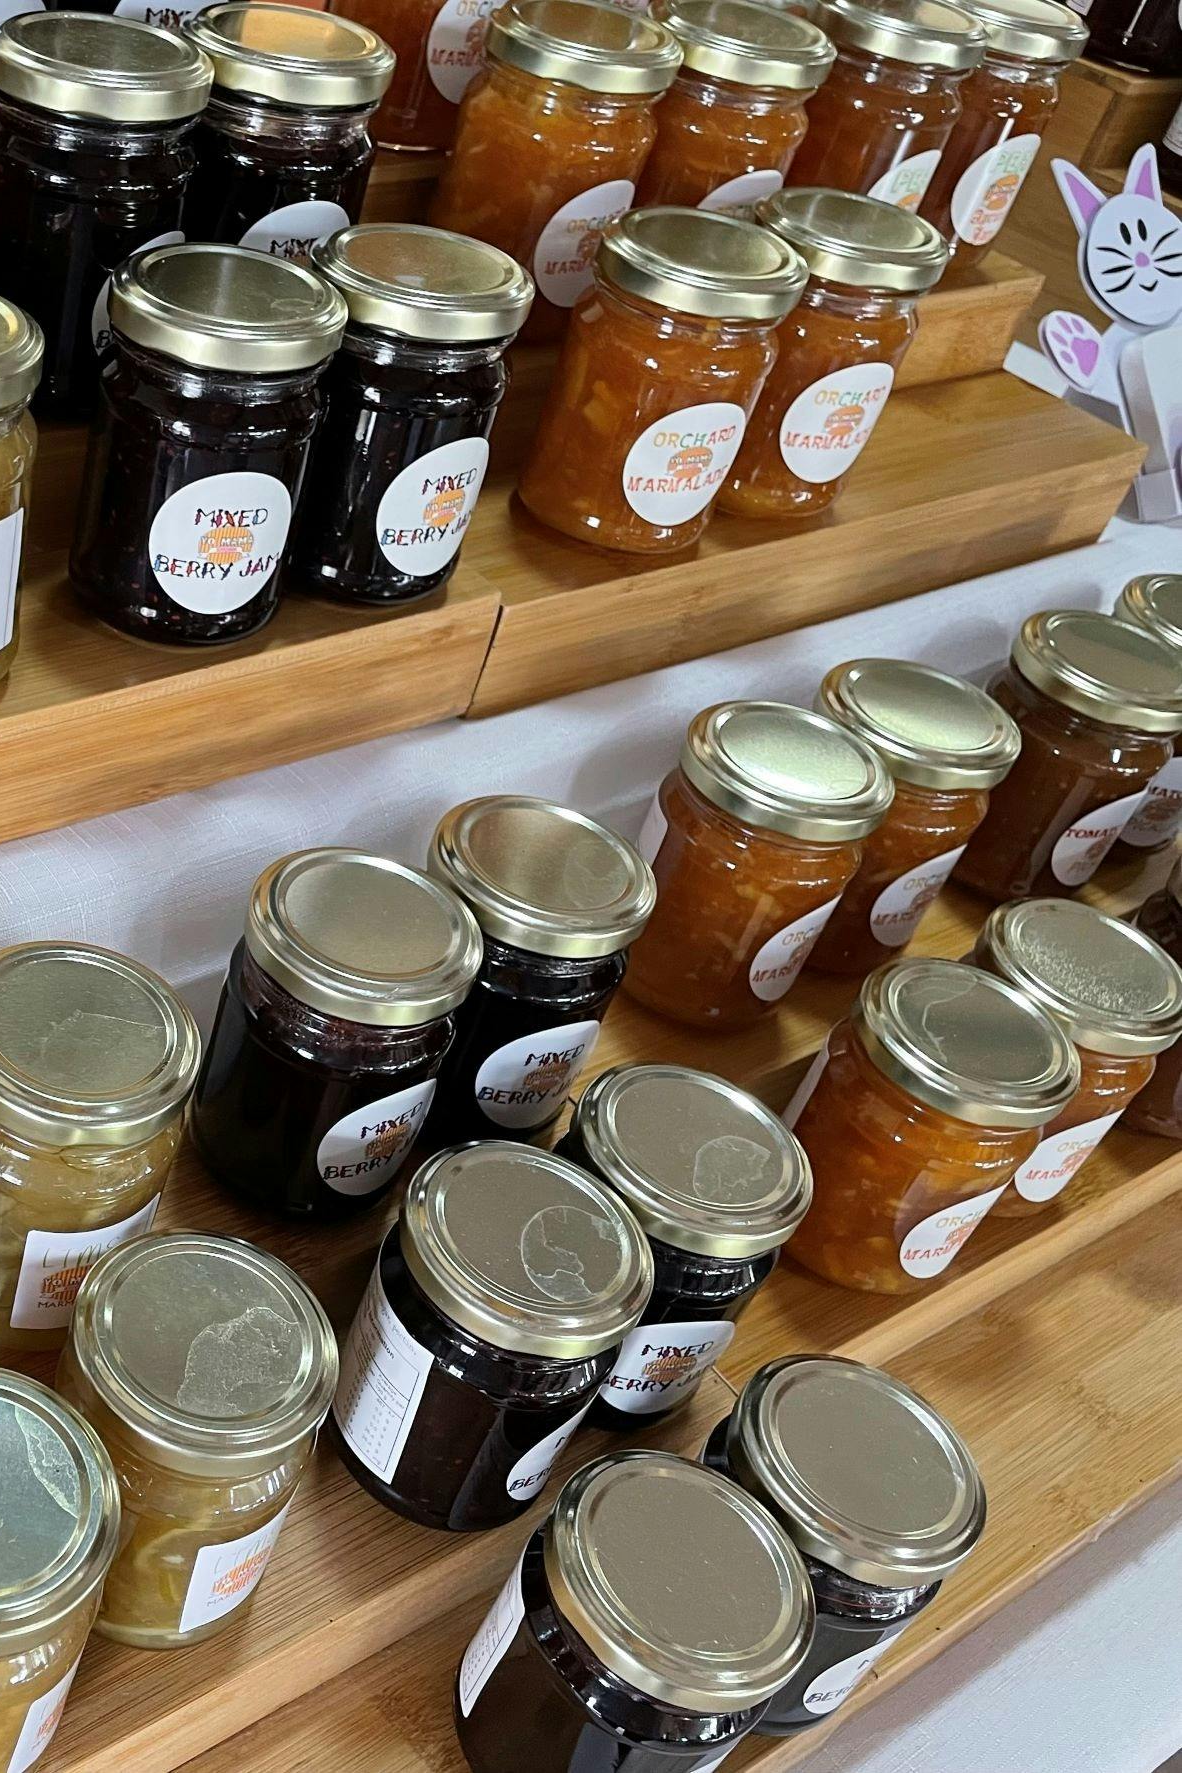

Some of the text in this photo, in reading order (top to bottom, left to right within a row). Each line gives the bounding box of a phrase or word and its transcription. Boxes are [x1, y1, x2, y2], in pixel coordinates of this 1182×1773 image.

[422, 468, 478, 495] MIXED
[194, 508, 268, 528] MIXED
[380, 523, 450, 546] BERRY
[153, 551, 281, 580] BERRY JAM
[523, 1043, 585, 1067] MIXED
[476, 1086, 550, 1104] BERRY
[360, 1101, 423, 1139] MIXED
[323, 1149, 396, 1180] BERRY
[641, 1341, 714, 1359] MIXED
[605, 1375, 673, 1392] ERRY
